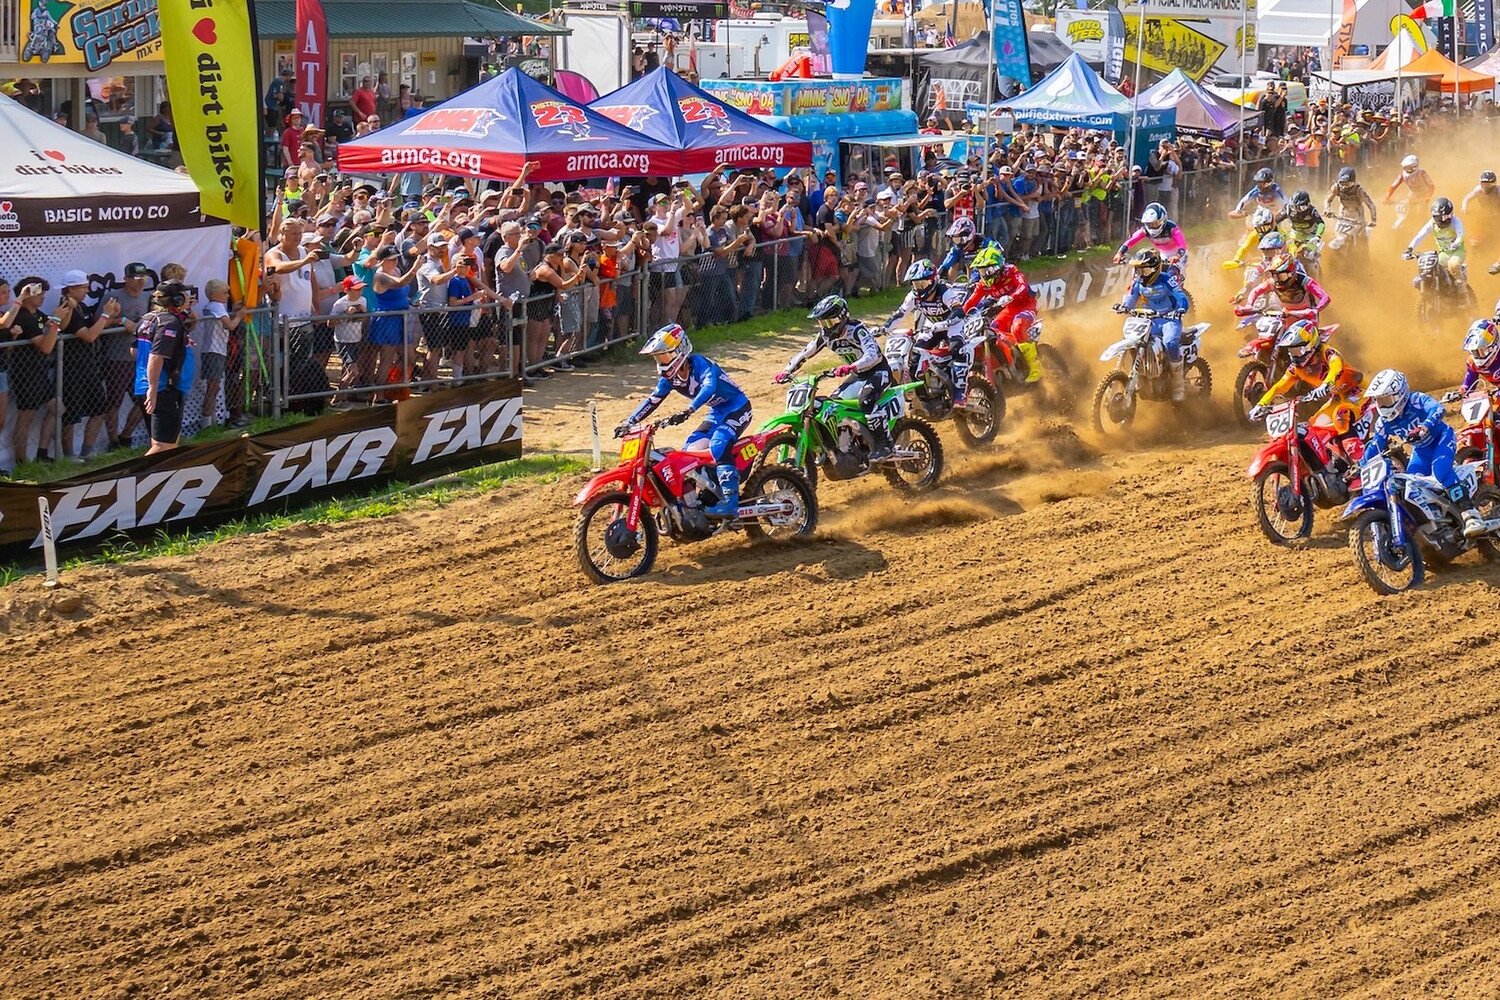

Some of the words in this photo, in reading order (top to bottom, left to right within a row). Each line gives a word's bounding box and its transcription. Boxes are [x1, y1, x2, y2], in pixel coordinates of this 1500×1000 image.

[190, 0, 213, 10] i
[660, 4, 698, 12] MONSTER
[1011, 1, 1019, 27] SOLD
[1068, 20, 1101, 33] MOTO
[1073, 29, 1104, 43] TEES
[136, 44, 153, 60] MX
[302, 20, 321, 129] ATM
[198, 53, 224, 116] dirt
[761, 92, 774, 107] DA
[799, 88, 826, 108] MINNE
[856, 86, 870, 105] DA
[1350, 91, 1392, 105] SUPPORT
[535, 107, 587, 128] 23
[682, 101, 728, 123] 23
[30, 151, 46, 161] i
[206, 123, 235, 204] bikes
[381, 148, 482, 174] armca.org
[567, 152, 650, 173] armca.org
[715, 145, 784, 165] armca.org
[15, 165, 58, 176] dirt
[61, 164, 123, 175] bikes
[44, 207, 92, 222] BASIC
[98, 206, 144, 220] MOTO
[148, 205, 169, 218] CO
[1124, 323, 1147, 336] 24
[1258, 322, 1280, 333] 51
[889, 338, 906, 354] 32
[1182, 343, 1198, 362] 24
[788, 389, 807, 407] 70
[1470, 402, 1482, 420] 1
[1269, 418, 1291, 436] 96
[1355, 419, 1371, 439] 96
[623, 441, 638, 458] 18
[741, 443, 758, 461] 18
[248, 427, 399, 507] FXR
[1361, 461, 1384, 485] 37
[29, 464, 223, 549] FXR
[630, 495, 639, 525] DUNLOP
